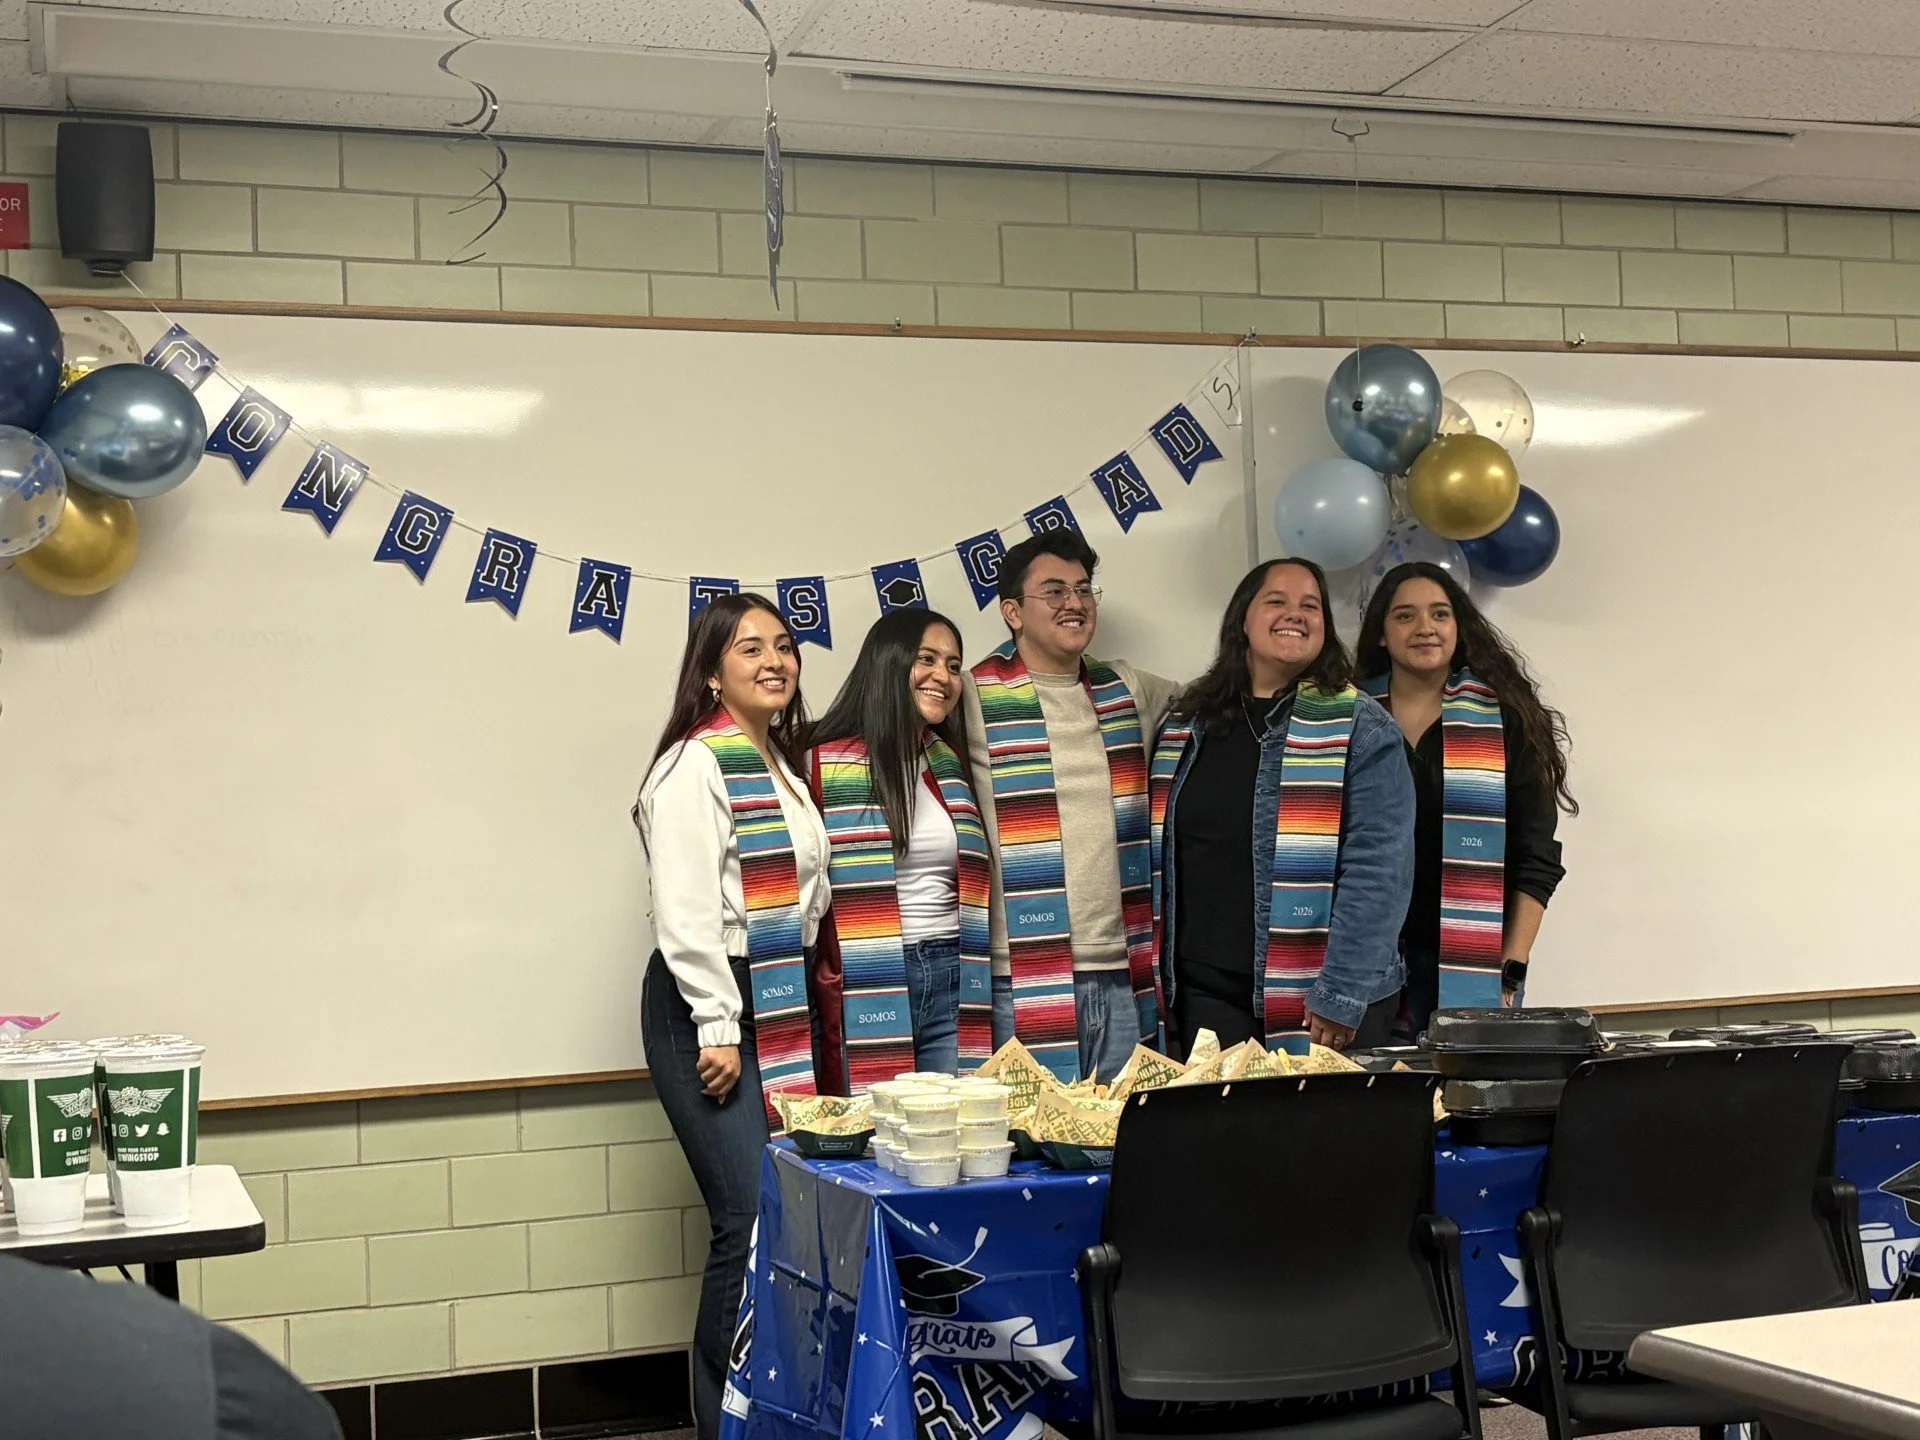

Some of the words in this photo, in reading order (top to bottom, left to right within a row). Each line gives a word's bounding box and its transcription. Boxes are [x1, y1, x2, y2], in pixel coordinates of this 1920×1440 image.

[1460, 836, 1483, 847] 2026
[1292, 906, 1314, 916] 2026
[1019, 912, 1055, 924] SOMOS
[762, 985, 794, 999] SOMOS
[858, 1011, 896, 1024] SOMOS
